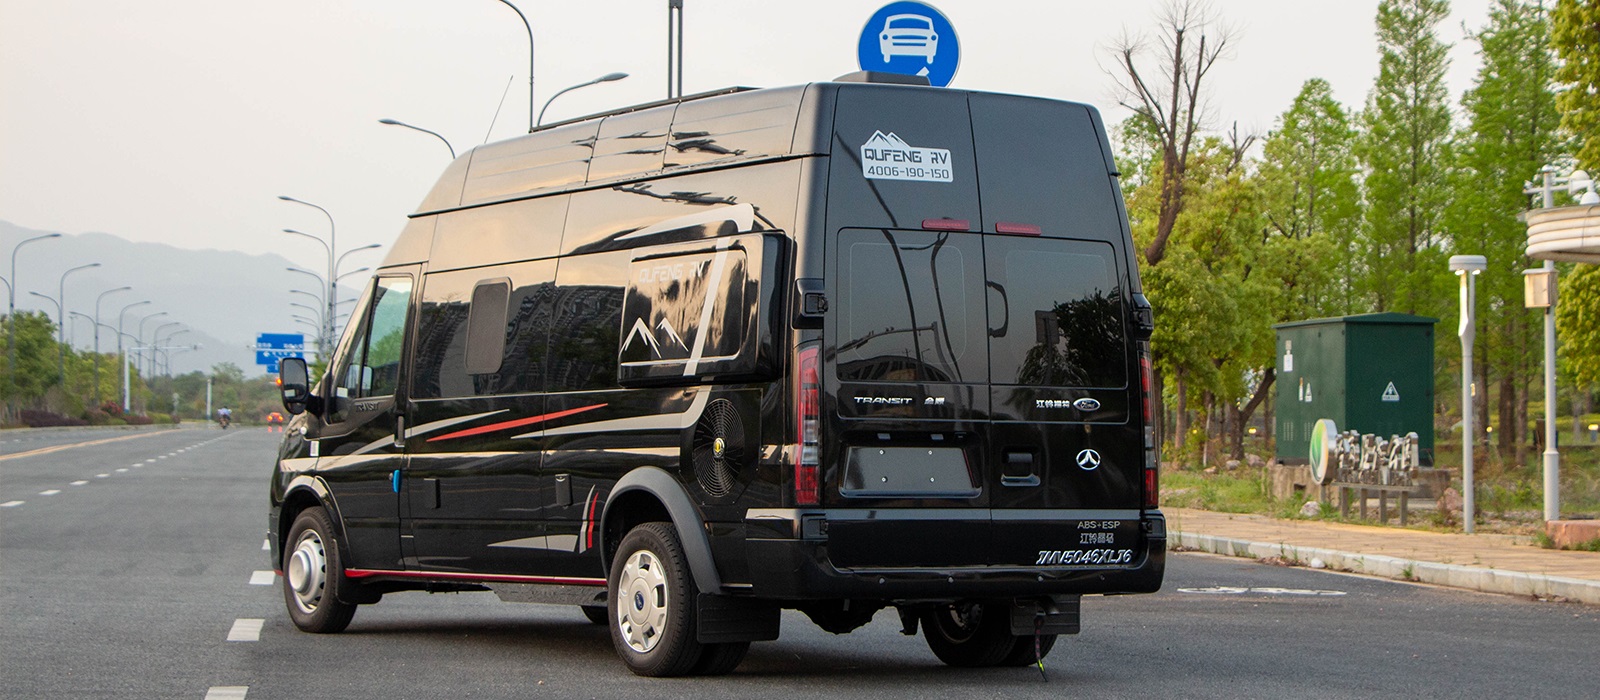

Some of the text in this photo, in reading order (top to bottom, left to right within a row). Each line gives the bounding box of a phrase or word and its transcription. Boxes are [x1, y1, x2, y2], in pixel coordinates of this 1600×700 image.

[864, 148, 948, 165] QUFENG RV
[867, 165, 950, 179] 4006-190-150
[639, 263, 684, 284] QUFENG
[853, 396, 913, 405] TRANSIT
